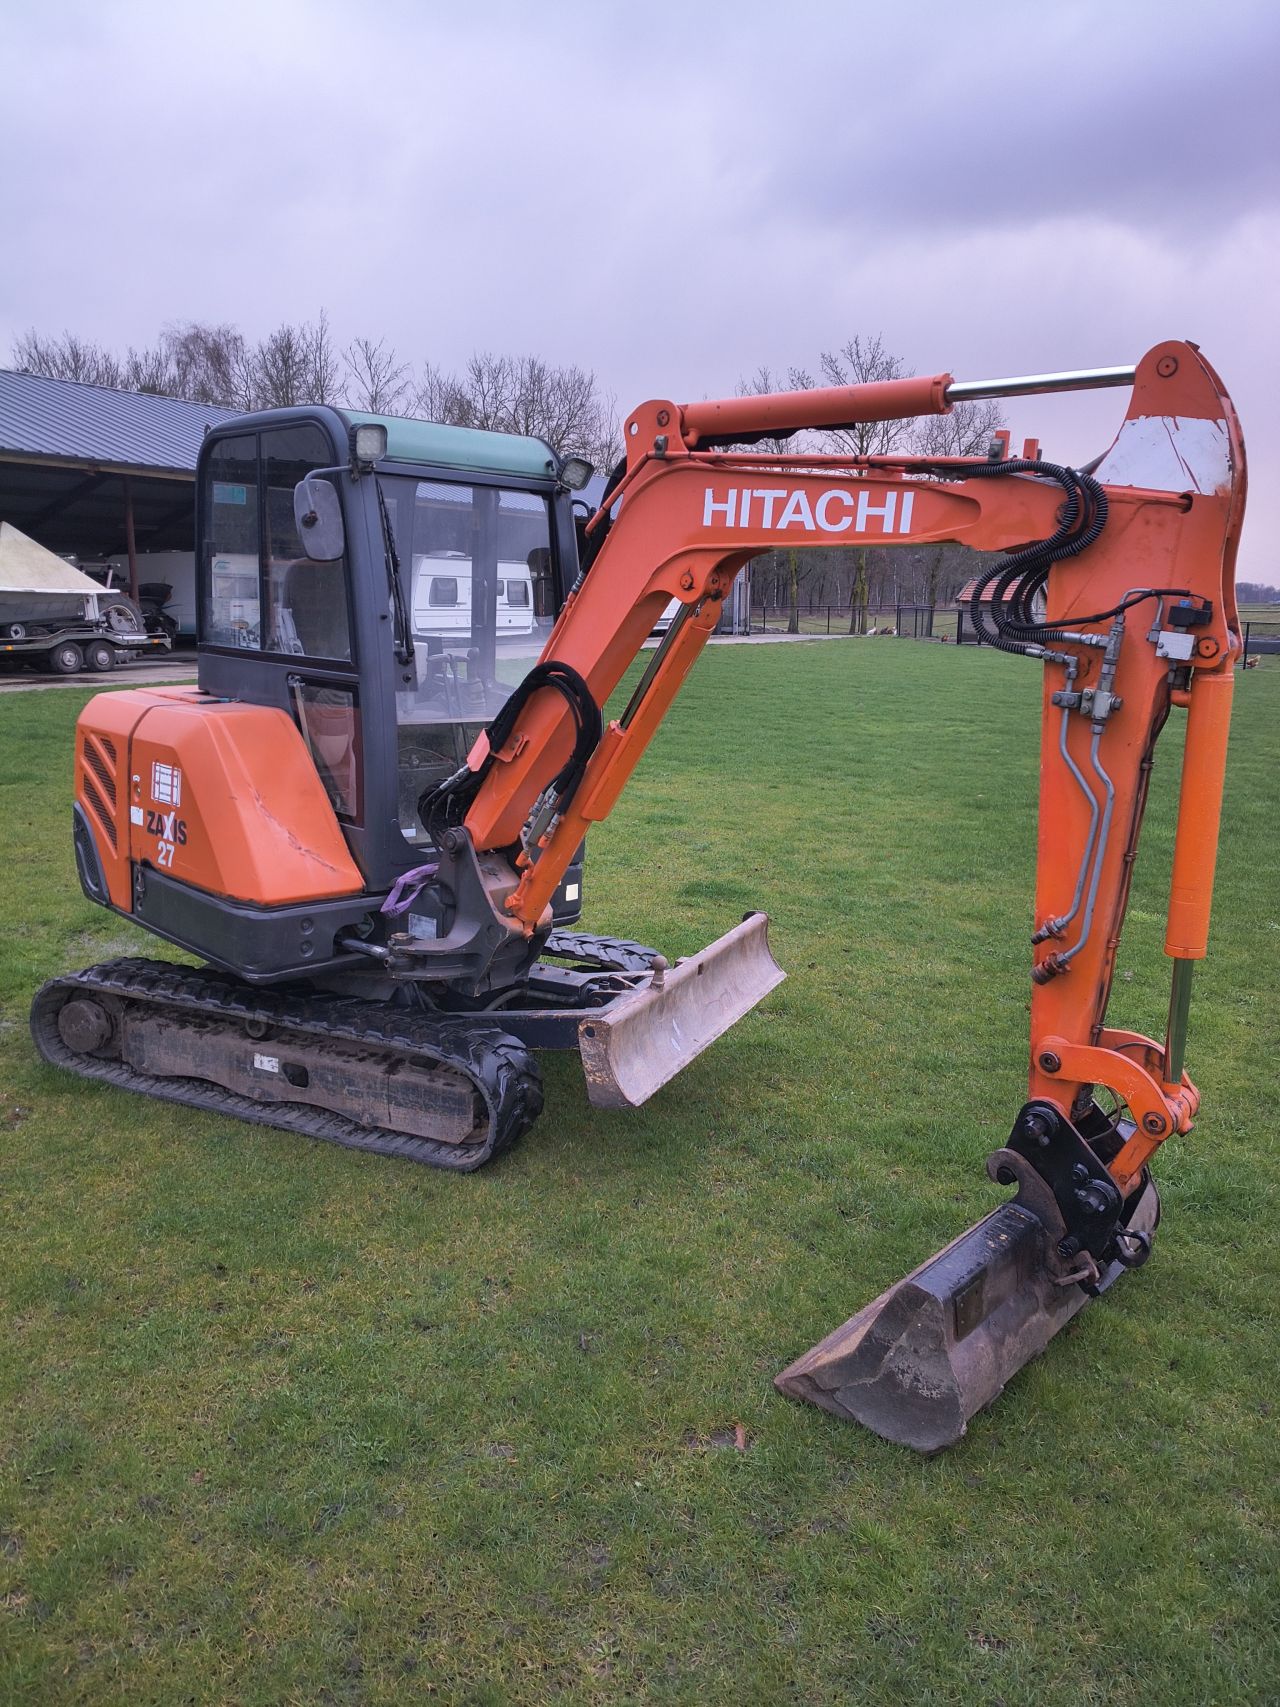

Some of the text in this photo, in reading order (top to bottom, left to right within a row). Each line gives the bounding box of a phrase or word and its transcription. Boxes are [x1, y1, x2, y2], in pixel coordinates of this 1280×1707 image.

[702, 488, 915, 534] HITACHI
[147, 810, 187, 846] ZAXIS
[157, 840, 175, 868] 27
